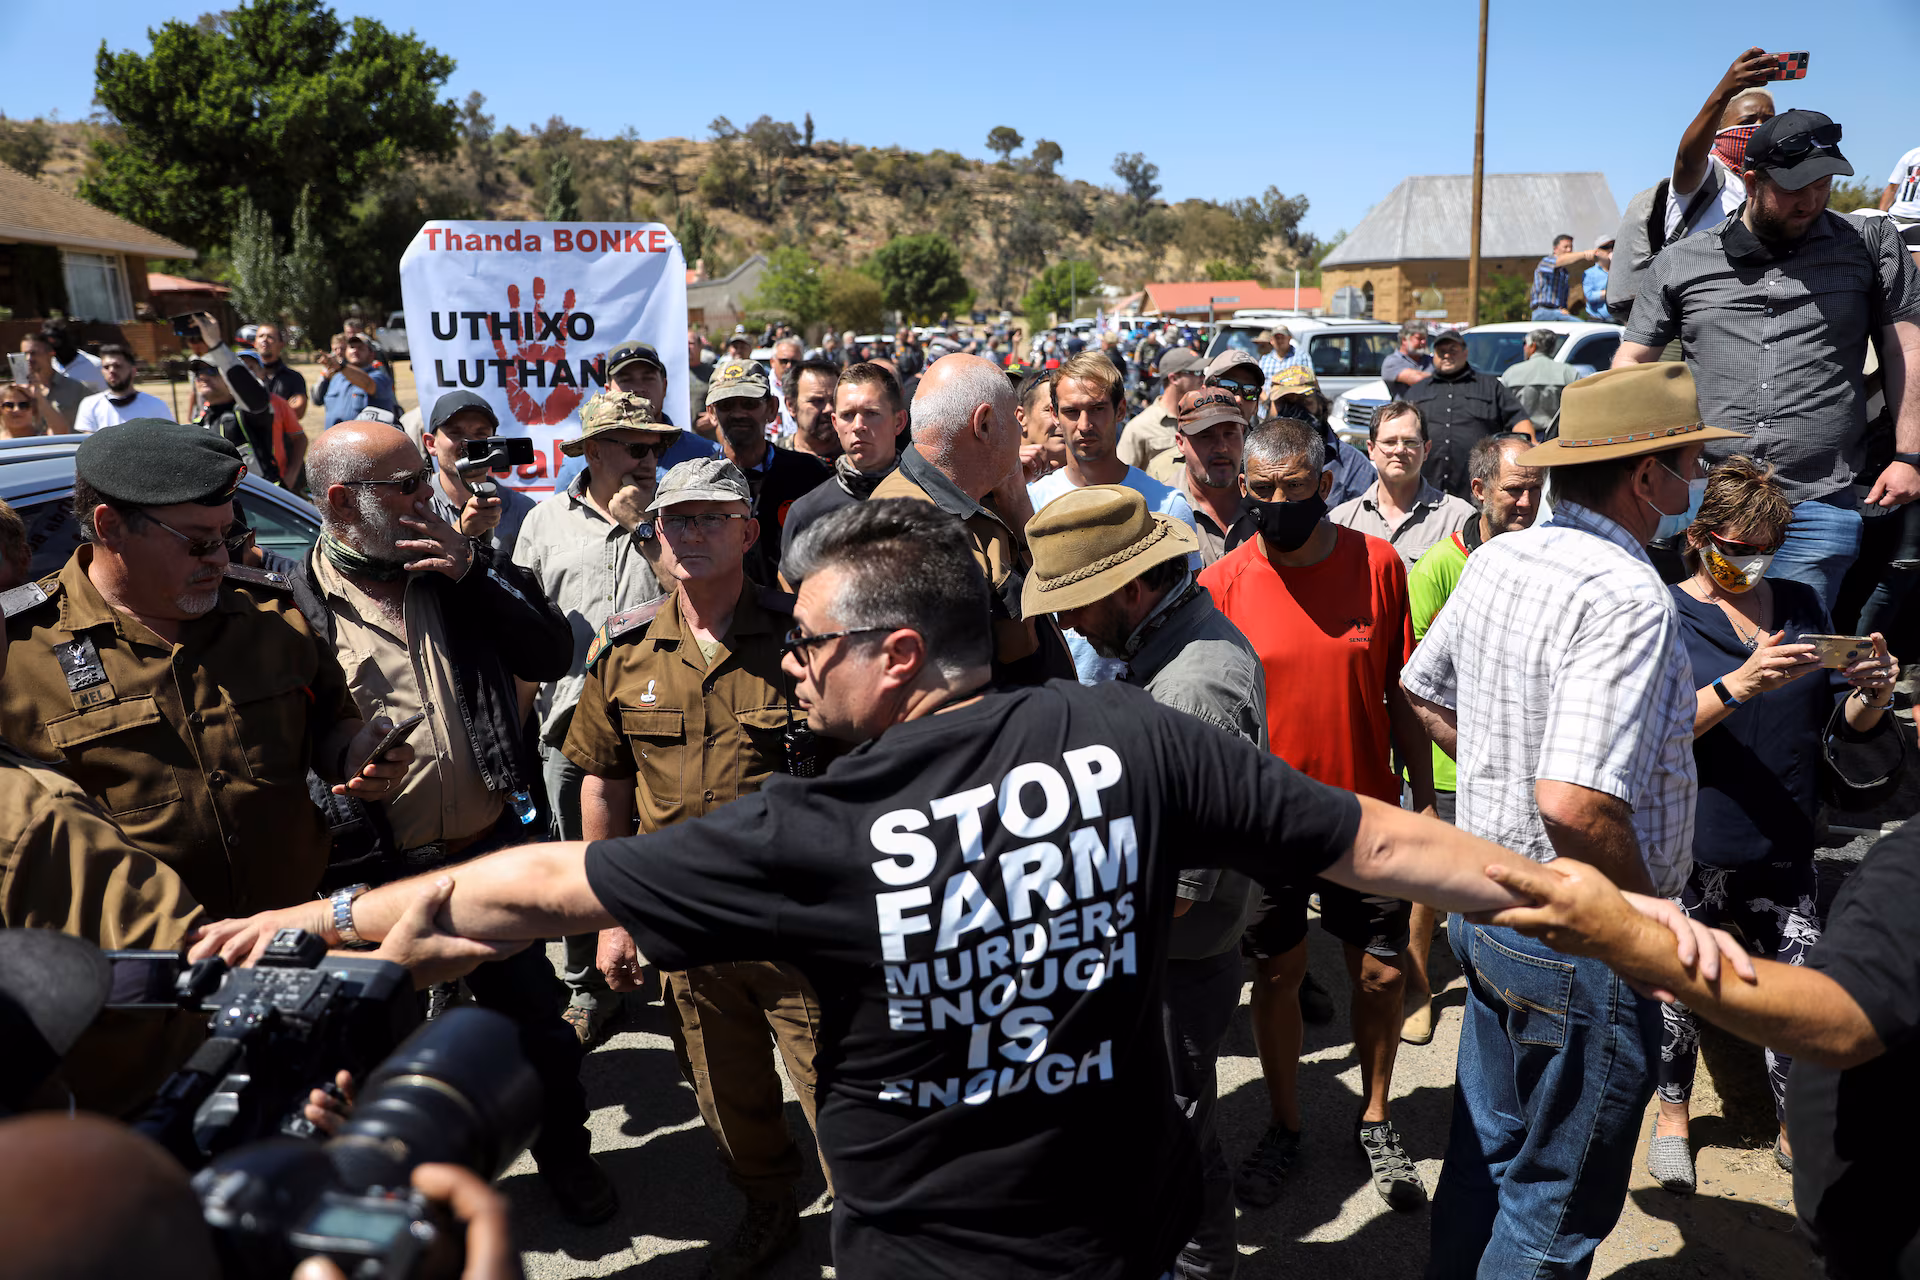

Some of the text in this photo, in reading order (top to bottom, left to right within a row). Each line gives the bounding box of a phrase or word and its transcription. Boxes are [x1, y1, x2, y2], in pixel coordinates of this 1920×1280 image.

[423, 228, 667, 253] Thanda BONKE
[431, 311, 595, 341] UTHIXO
[79, 690, 107, 706] NEL
[869, 744, 1123, 886] STOP
[875, 815, 1139, 962] FARM
[883, 891, 1136, 996] MURDERS
[888, 932, 1137, 1031] ENOUGH
[967, 1005, 1054, 1069] IS
[878, 1039, 1114, 1107] ENOUGH
